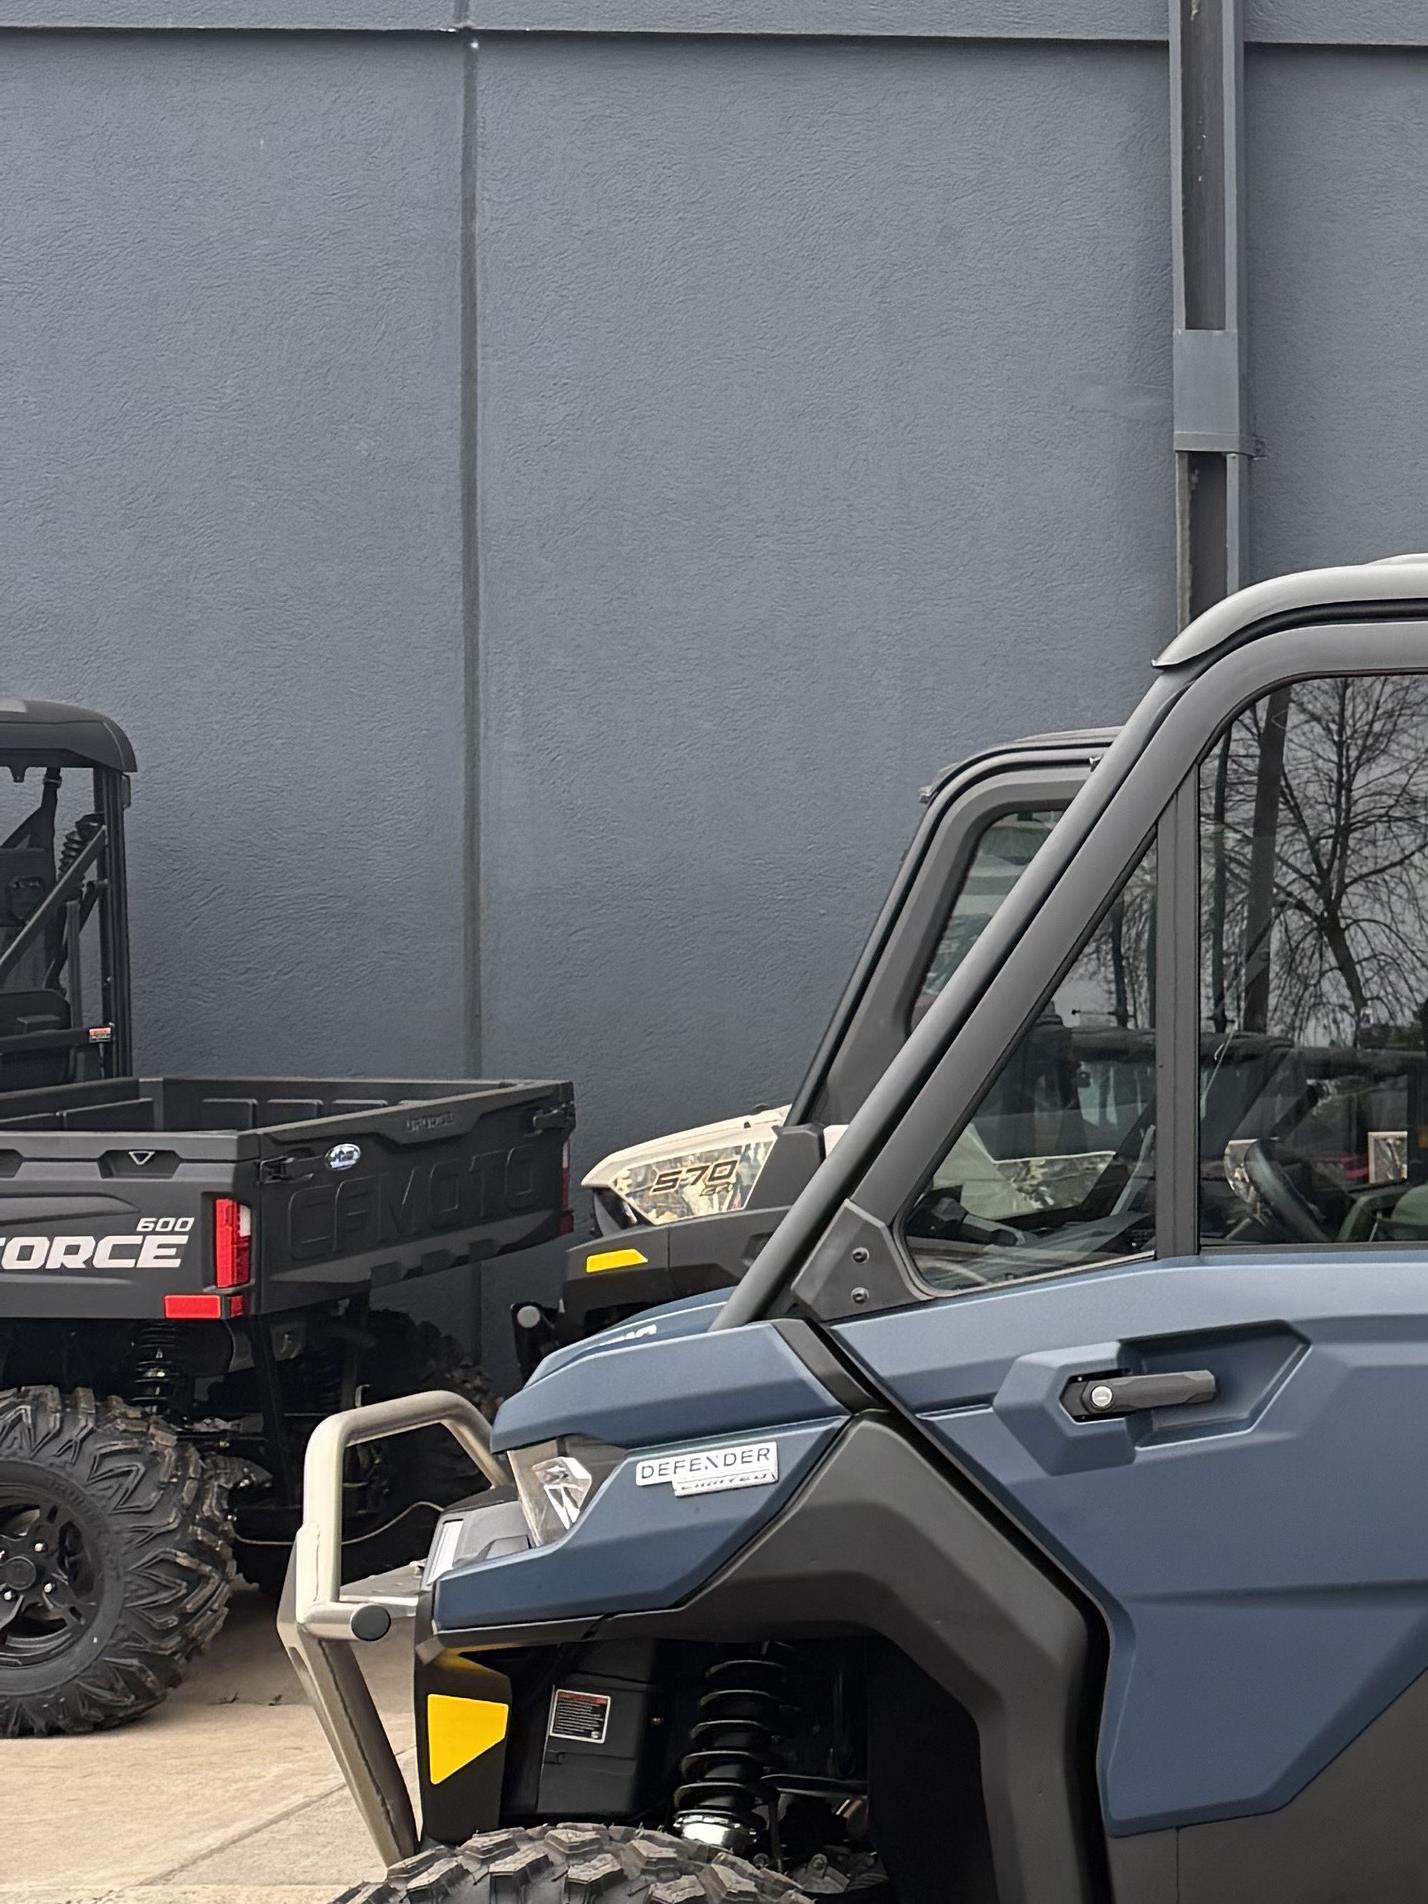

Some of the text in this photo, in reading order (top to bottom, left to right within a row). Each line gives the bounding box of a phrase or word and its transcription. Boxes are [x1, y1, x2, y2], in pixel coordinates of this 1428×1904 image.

[136, 1217, 195, 1232] 600
[0, 1235, 189, 1270] ORCE
[641, 1447, 770, 1480] DEFENDER
